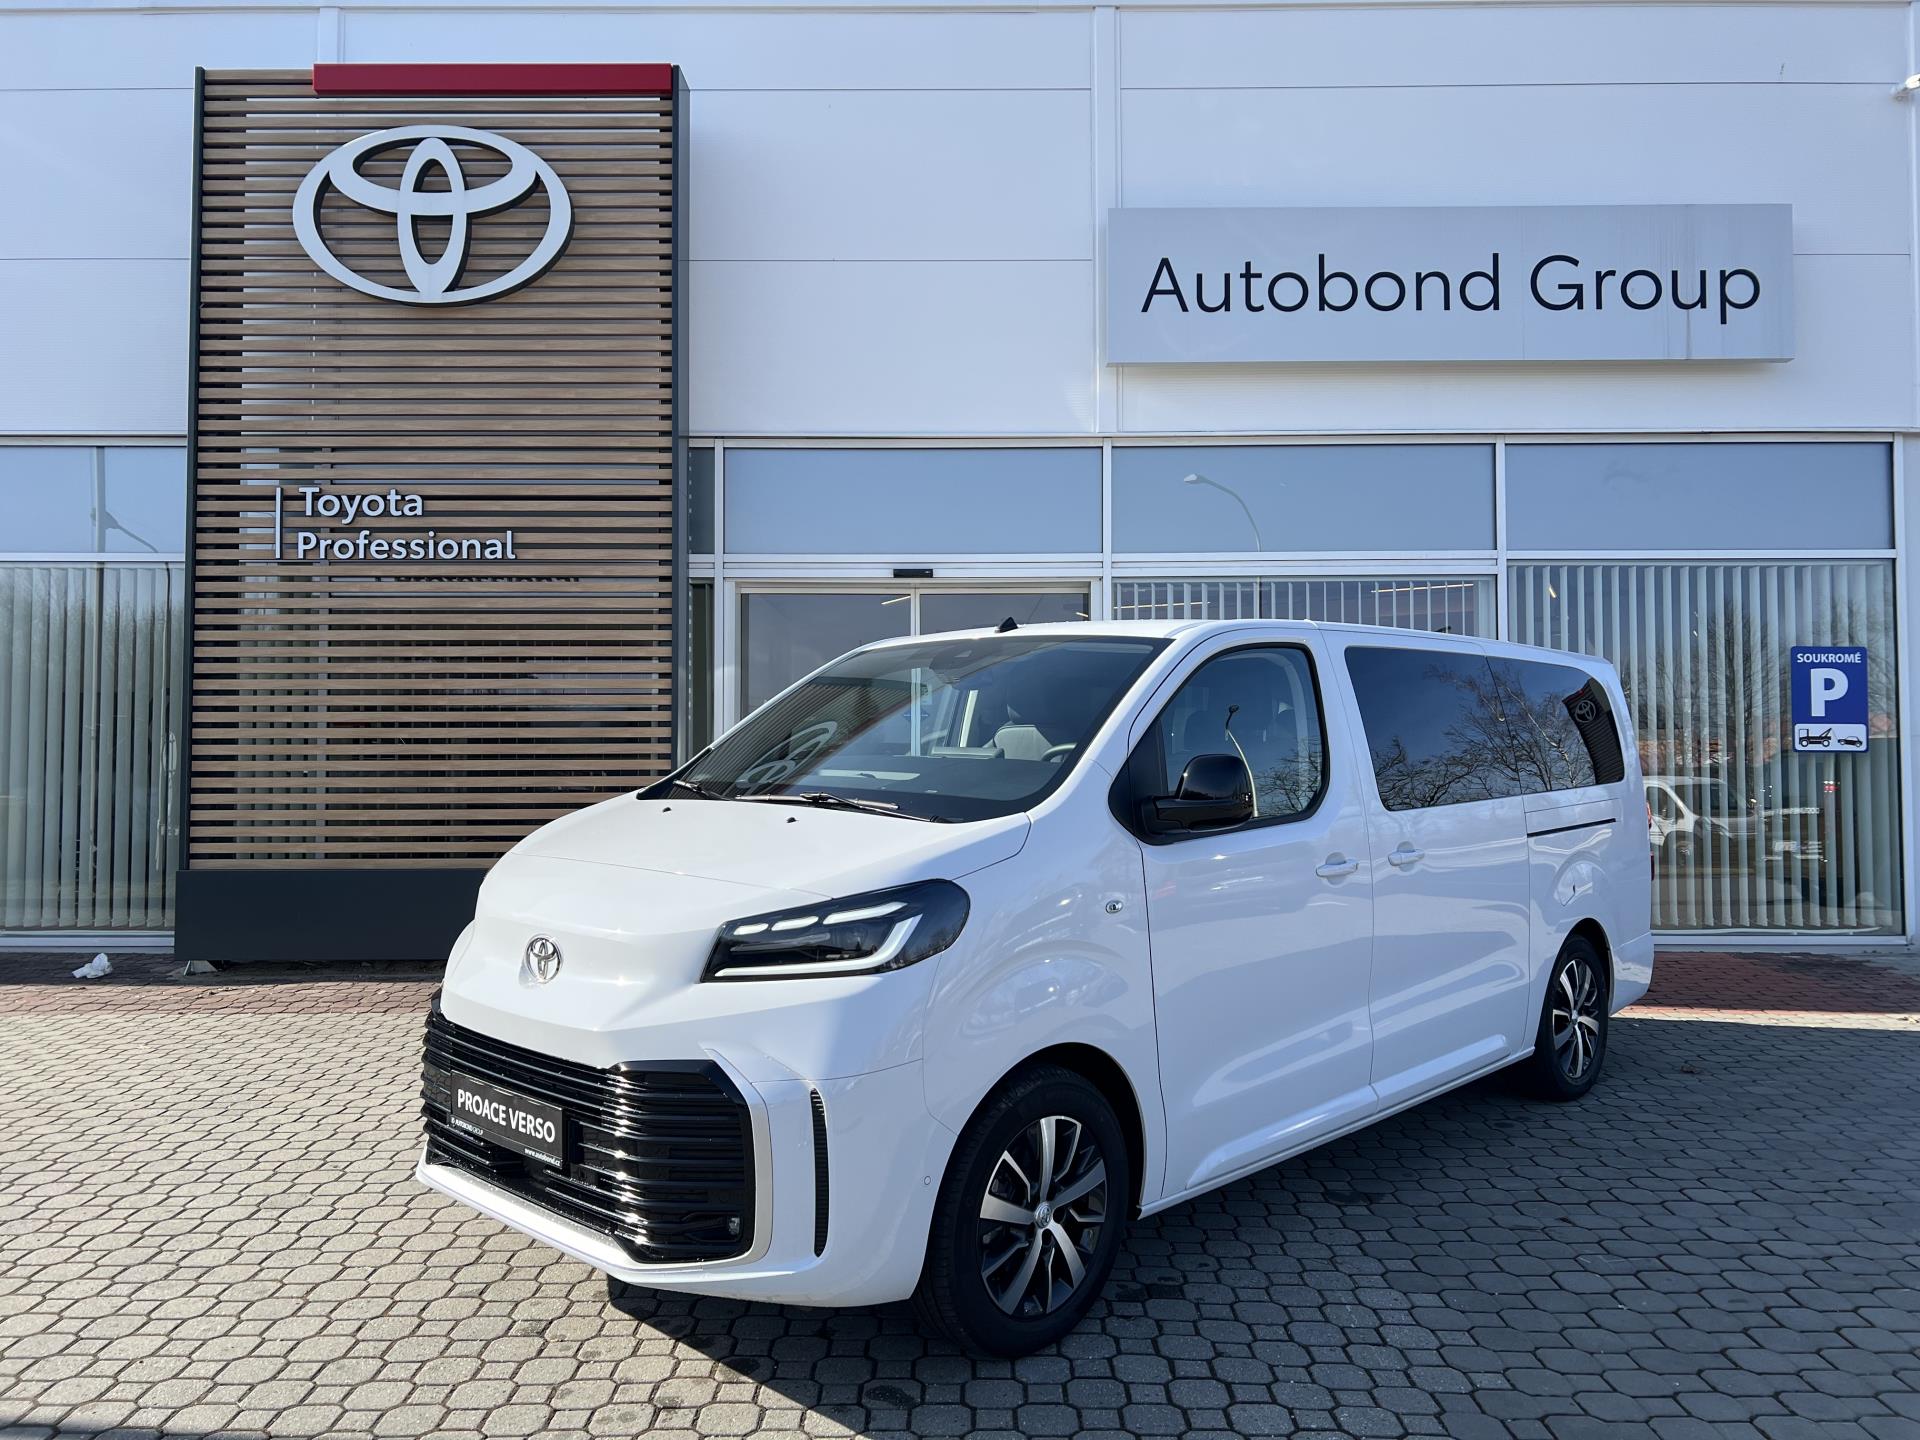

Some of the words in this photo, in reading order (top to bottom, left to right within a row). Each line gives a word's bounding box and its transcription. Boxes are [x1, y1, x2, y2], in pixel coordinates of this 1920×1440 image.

[1141, 252, 1500, 313] Autobond
[1529, 253, 1761, 325] Group
[298, 486, 424, 525] Toyota
[296, 530, 516, 560] Professional
[1796, 652, 1862, 664] SOUKROMÉ
[1810, 667, 1849, 717] P
[457, 1088, 507, 1127] PROACE
[508, 1107, 556, 1143] VERSO
